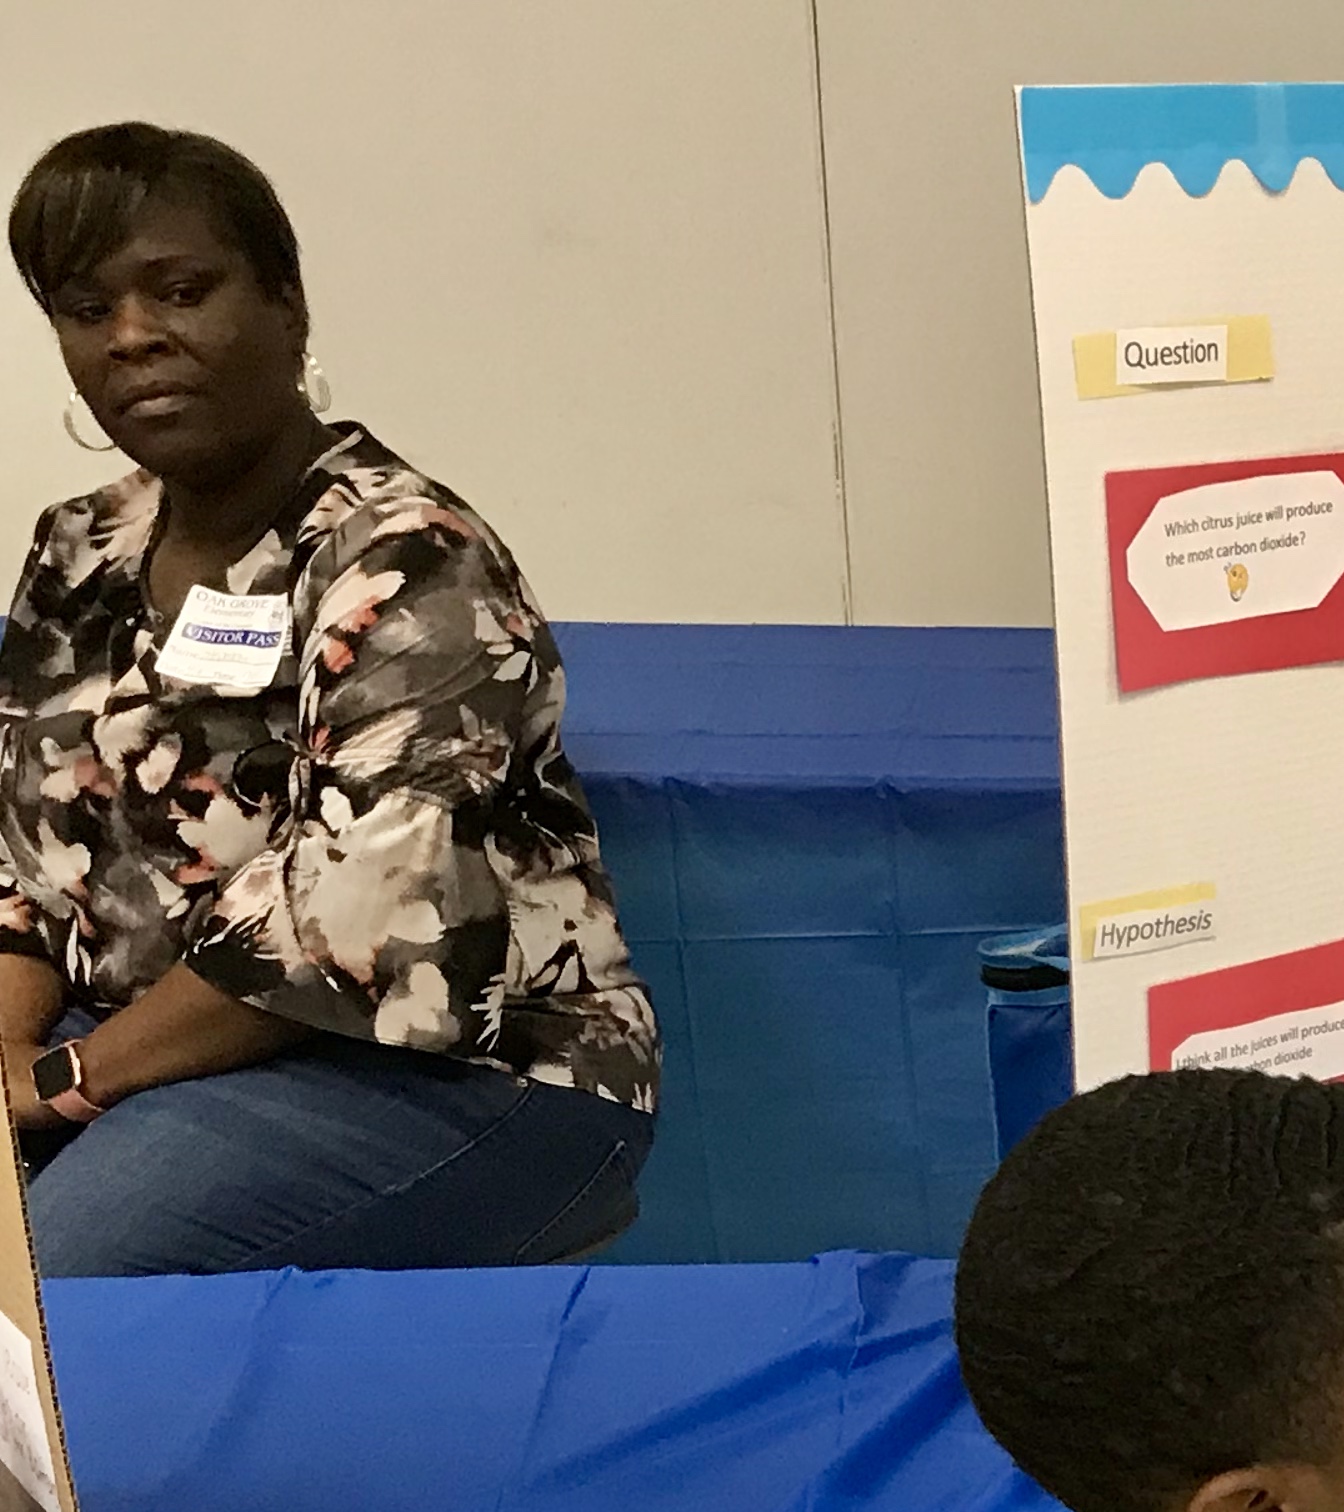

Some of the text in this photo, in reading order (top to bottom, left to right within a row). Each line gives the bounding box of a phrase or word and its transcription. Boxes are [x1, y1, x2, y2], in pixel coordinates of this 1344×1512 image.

[1124, 338, 1219, 370] Question
[1164, 501, 1333, 537] Which citrus juice will produce
[1166, 531, 1306, 567] the most carbon dioxide?
[186, 626, 279, 647] VISITOR PASS
[1101, 909, 1212, 949] Hypothesis
[1214, 1047, 1227, 1061] all
[1230, 1043, 1248, 1057] the
[1251, 1036, 1278, 1054] juices
[1280, 1027, 1299, 1043] will
[1274, 1046, 1312, 1066] dioxide
